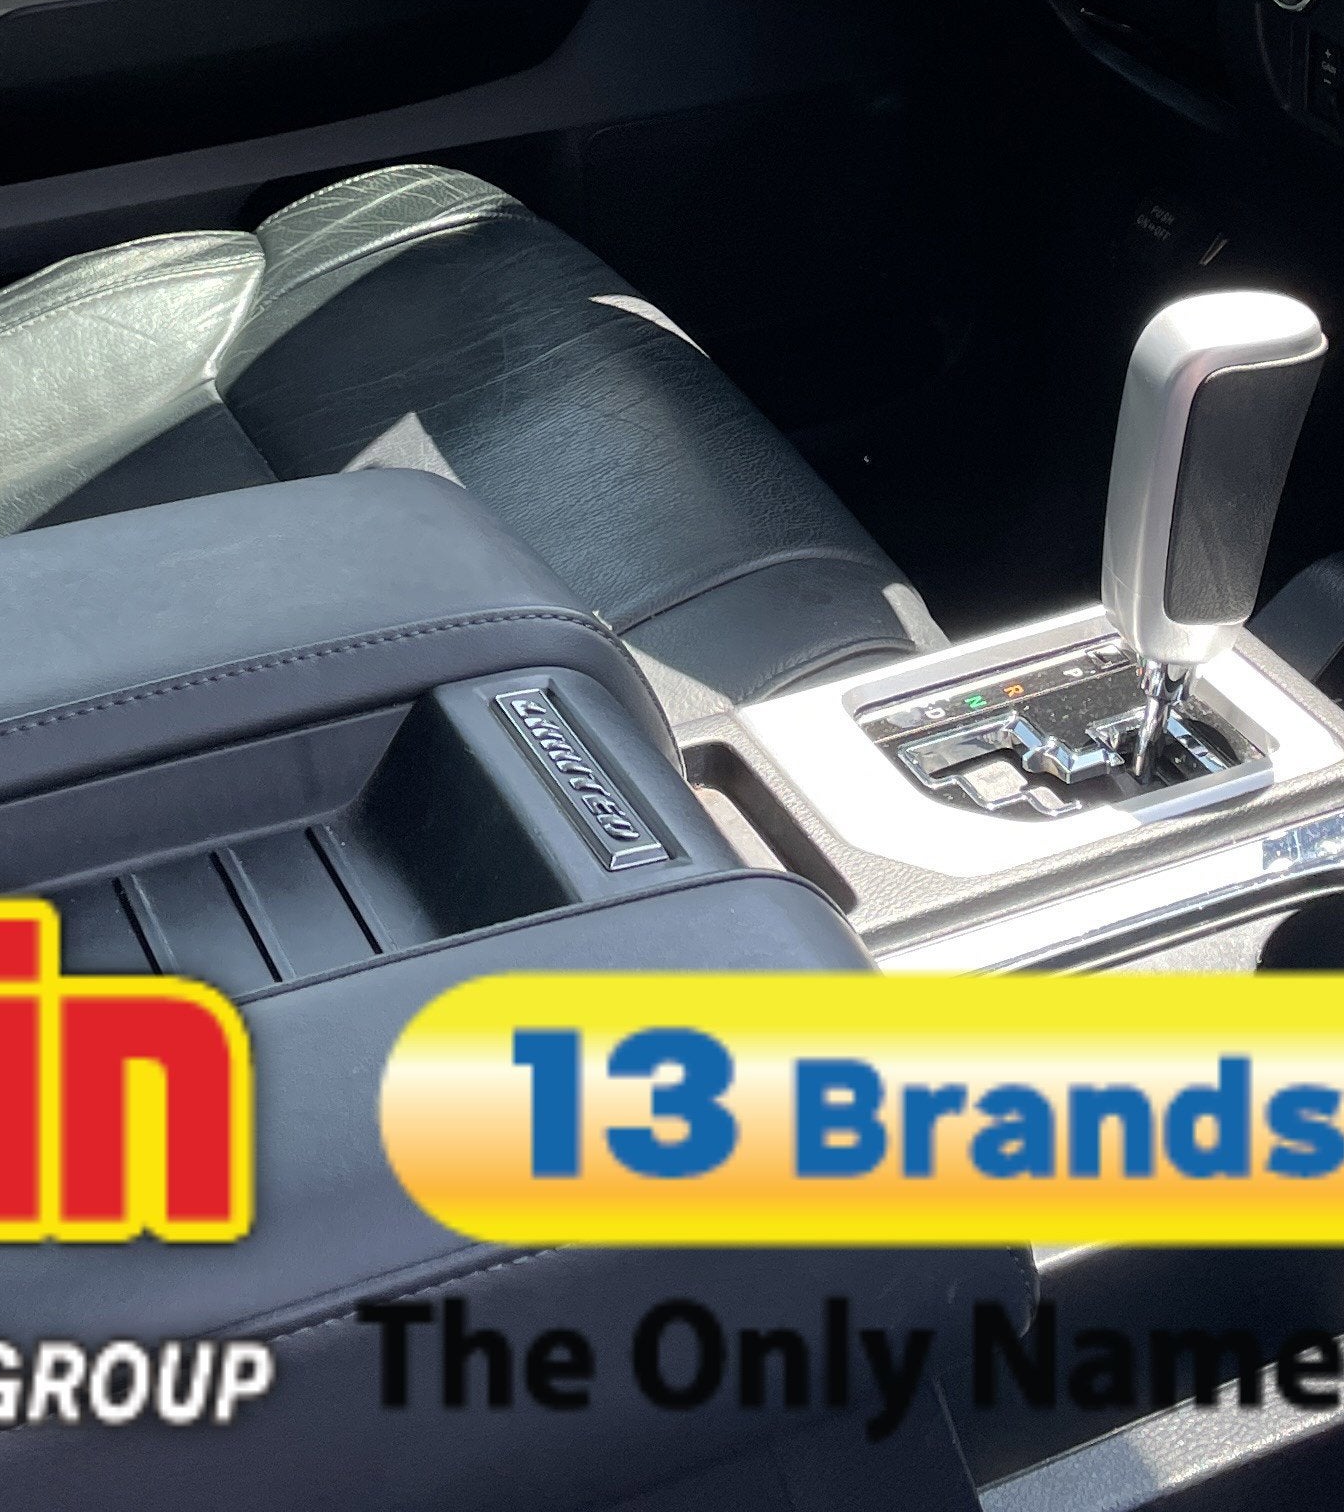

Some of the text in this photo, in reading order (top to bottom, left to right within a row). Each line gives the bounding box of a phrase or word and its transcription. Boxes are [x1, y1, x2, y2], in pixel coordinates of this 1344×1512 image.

[924, 667, 1084, 720] P R N D
[510, 699, 641, 839] LIMITED
